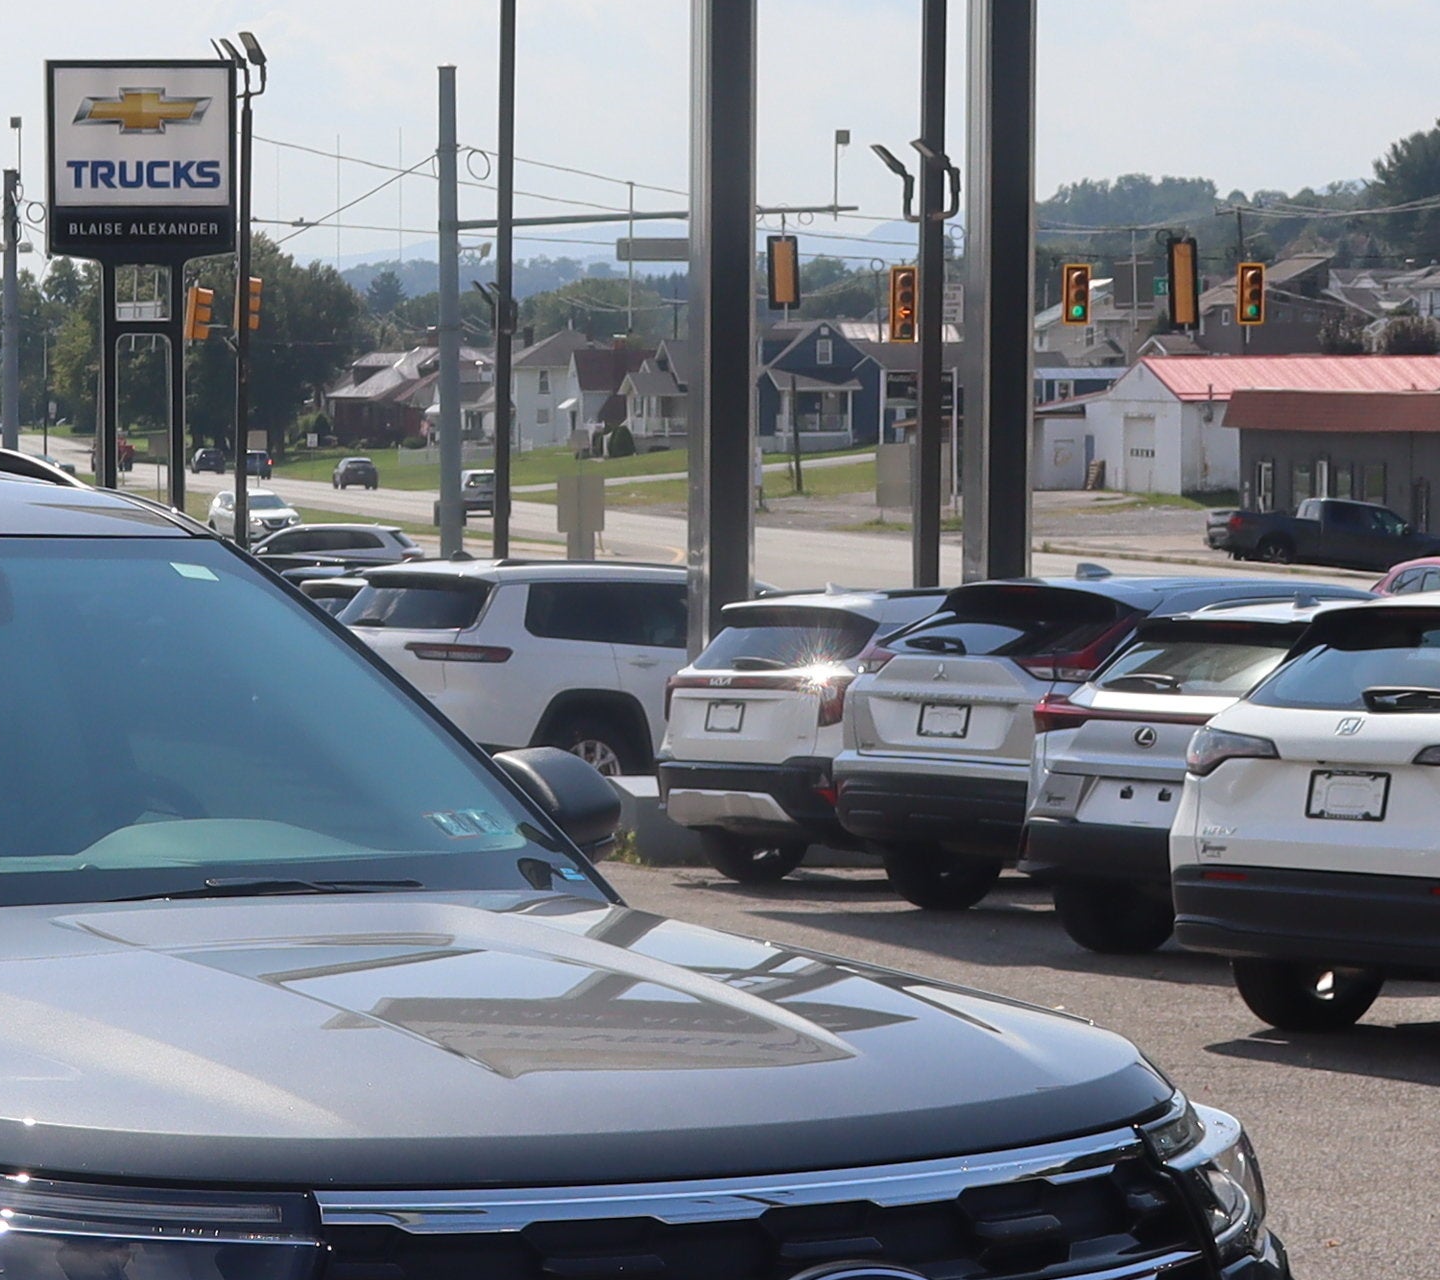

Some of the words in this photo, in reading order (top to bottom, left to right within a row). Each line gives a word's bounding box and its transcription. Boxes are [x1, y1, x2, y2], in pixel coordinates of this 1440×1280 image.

[67, 160, 221, 188] TRUCKS
[70, 223, 123, 235] BLAISE
[129, 223, 219, 235] ALEXANDER
